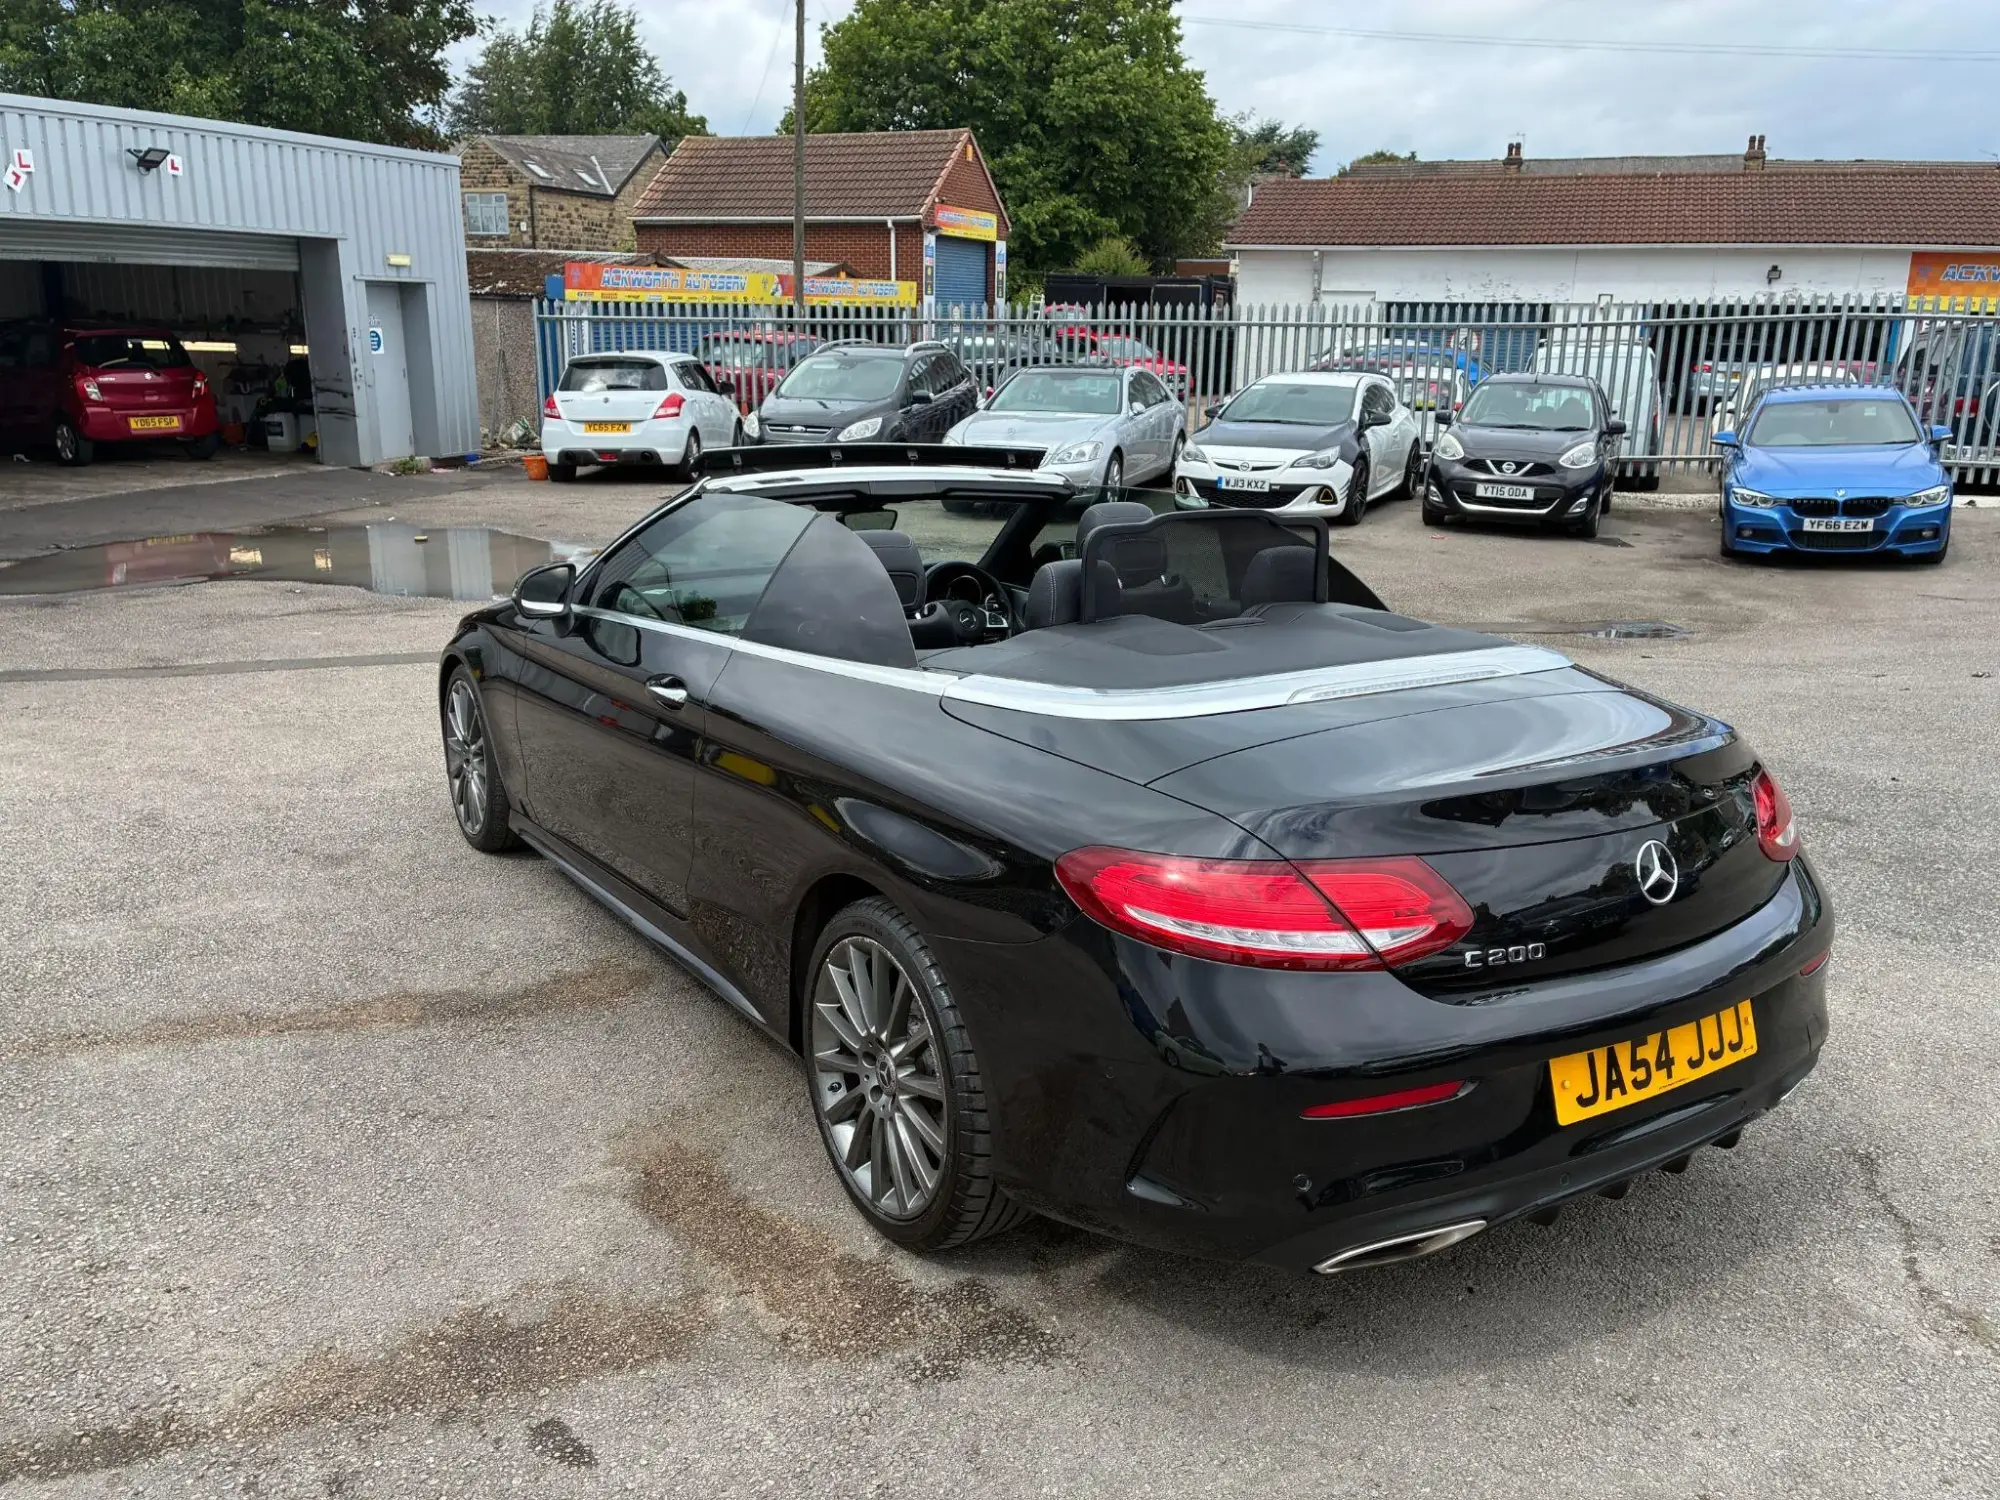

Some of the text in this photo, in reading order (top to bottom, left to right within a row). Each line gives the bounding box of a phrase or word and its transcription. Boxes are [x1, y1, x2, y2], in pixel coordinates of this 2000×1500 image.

[17, 151, 31, 169] L
[170, 158, 180, 172] L
[11, 170, 22, 186] L
[601, 267, 748, 291] ACKWORTH AUTOSERV
[587, 423, 609, 432] YC65
[1225, 478, 1266, 490] WJ13 KXZ
[1483, 485, 1528, 498] YT15 ODA
[1809, 519, 1869, 531] YF66 EZW
[1464, 942, 1547, 968] C 200
[1575, 1002, 1744, 1108] JA54 JJJ
